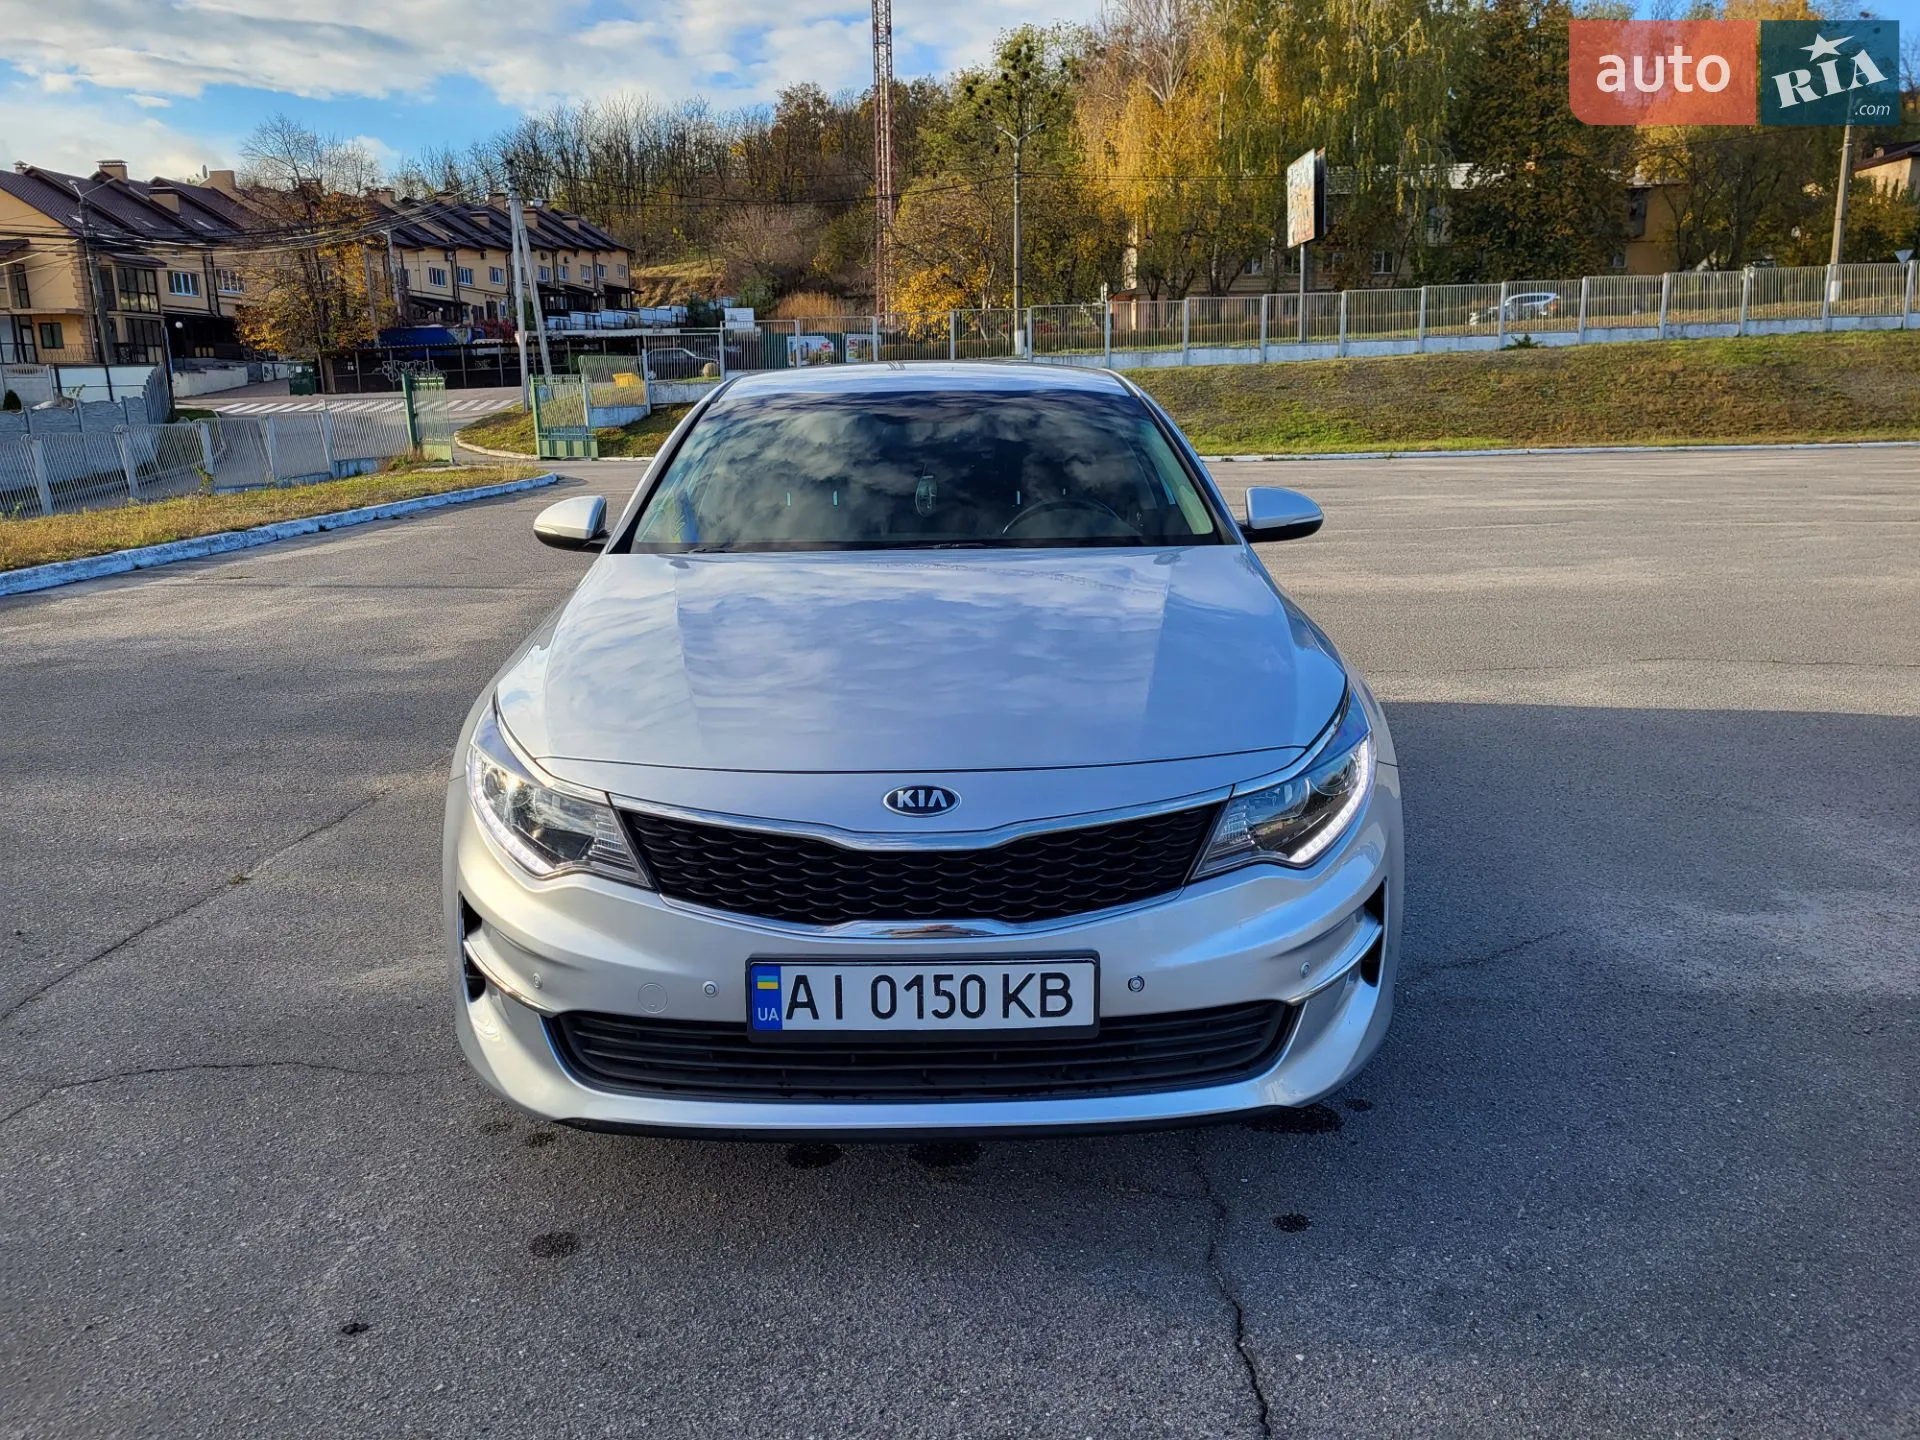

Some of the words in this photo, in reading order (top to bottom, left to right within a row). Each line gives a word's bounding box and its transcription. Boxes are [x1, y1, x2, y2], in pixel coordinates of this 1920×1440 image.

[897, 789, 947, 808] KIA
[785, 974, 843, 1020] AI
[870, 973, 986, 1020] 0150
[1001, 972, 1073, 1019] KB
[757, 1006, 780, 1022] UA
